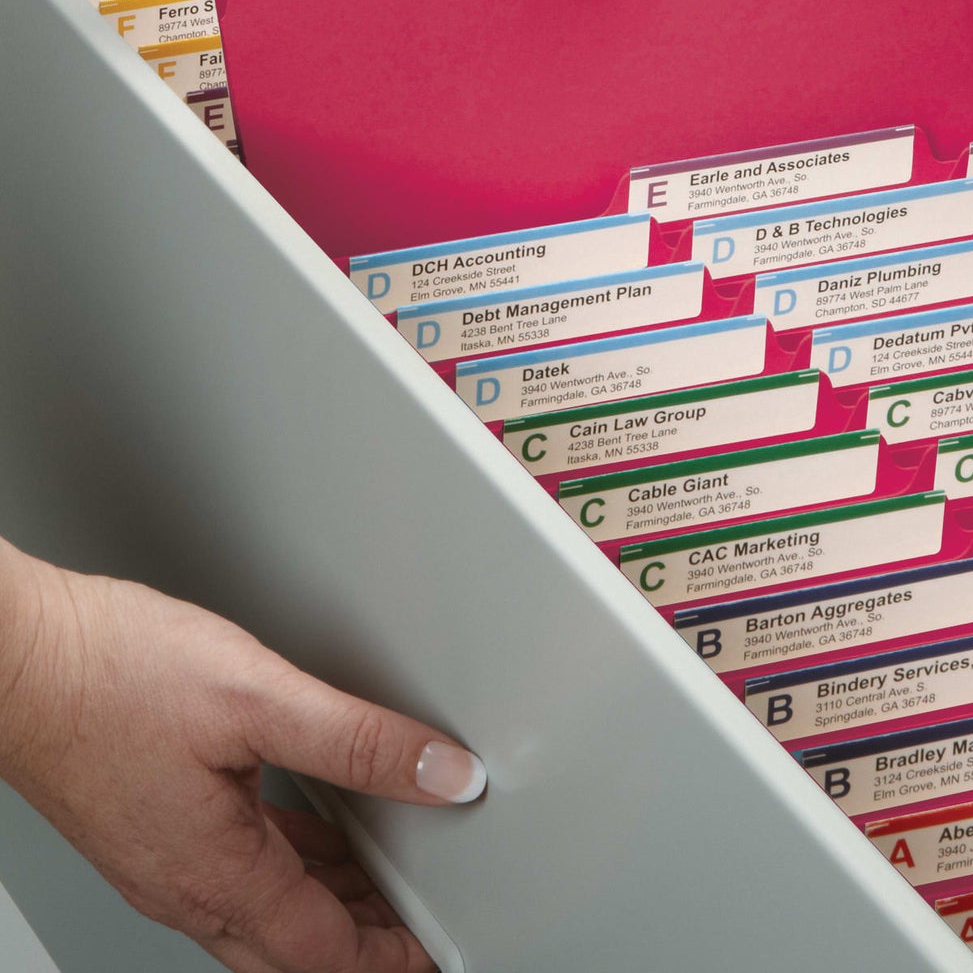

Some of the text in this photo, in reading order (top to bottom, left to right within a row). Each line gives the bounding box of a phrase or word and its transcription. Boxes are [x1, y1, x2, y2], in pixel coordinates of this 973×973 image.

[158, 4, 199, 19] Ferro
[158, 16, 214, 32] 89774 West
[118, 15, 136, 37] F
[205, 104, 224, 131] E
[689, 151, 851, 186] Earle and Associates
[411, 244, 546, 276] DCH Accounting
[817, 262, 942, 293] Daniz Plumbing
[461, 285, 652, 325] Debt Management Plan
[417, 321, 440, 349] D
[460, 315, 567, 338] 4238 Bent Tree Lane
[496, 334, 515, 345] MN
[517, 328, 550, 341] 55338
[872, 329, 945, 350] Dedatum
[521, 361, 570, 381] Datek
[568, 406, 707, 438] Cain Law Group
[627, 473, 729, 503] Cable Giant
[687, 531, 820, 565] CAC Marketing
[745, 590, 914, 632] Barton Aggregates
[816, 674, 888, 698] Bindery
[874, 747, 946, 771] Bradley
[824, 768, 850, 798] B
[873, 772, 902, 786] 3124
[905, 760, 963, 780] Creekside
[873, 789, 895, 800] Elm
[939, 773, 960, 786] MN
